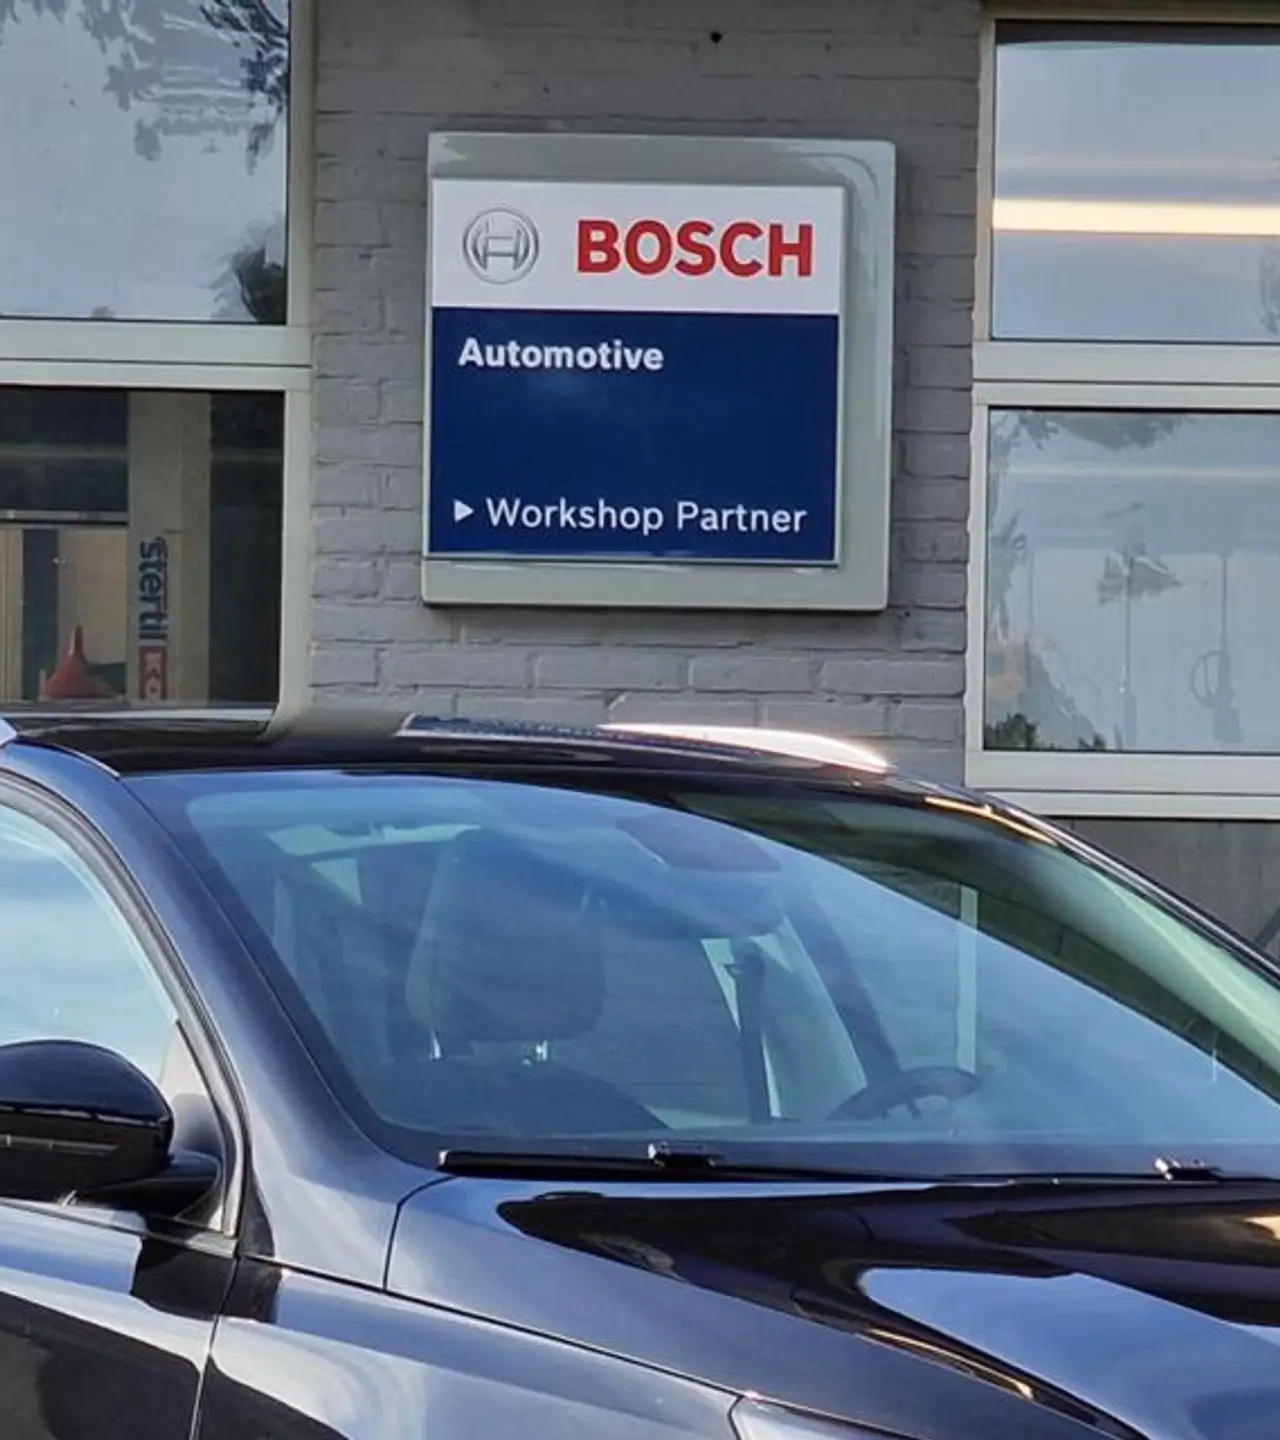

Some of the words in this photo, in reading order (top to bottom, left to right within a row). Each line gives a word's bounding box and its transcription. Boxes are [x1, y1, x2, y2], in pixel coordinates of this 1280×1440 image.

[577, 219, 814, 278] BOSCH
[458, 337, 664, 370] Automotive
[486, 498, 664, 535] Workshop
[676, 501, 807, 533] Partner
